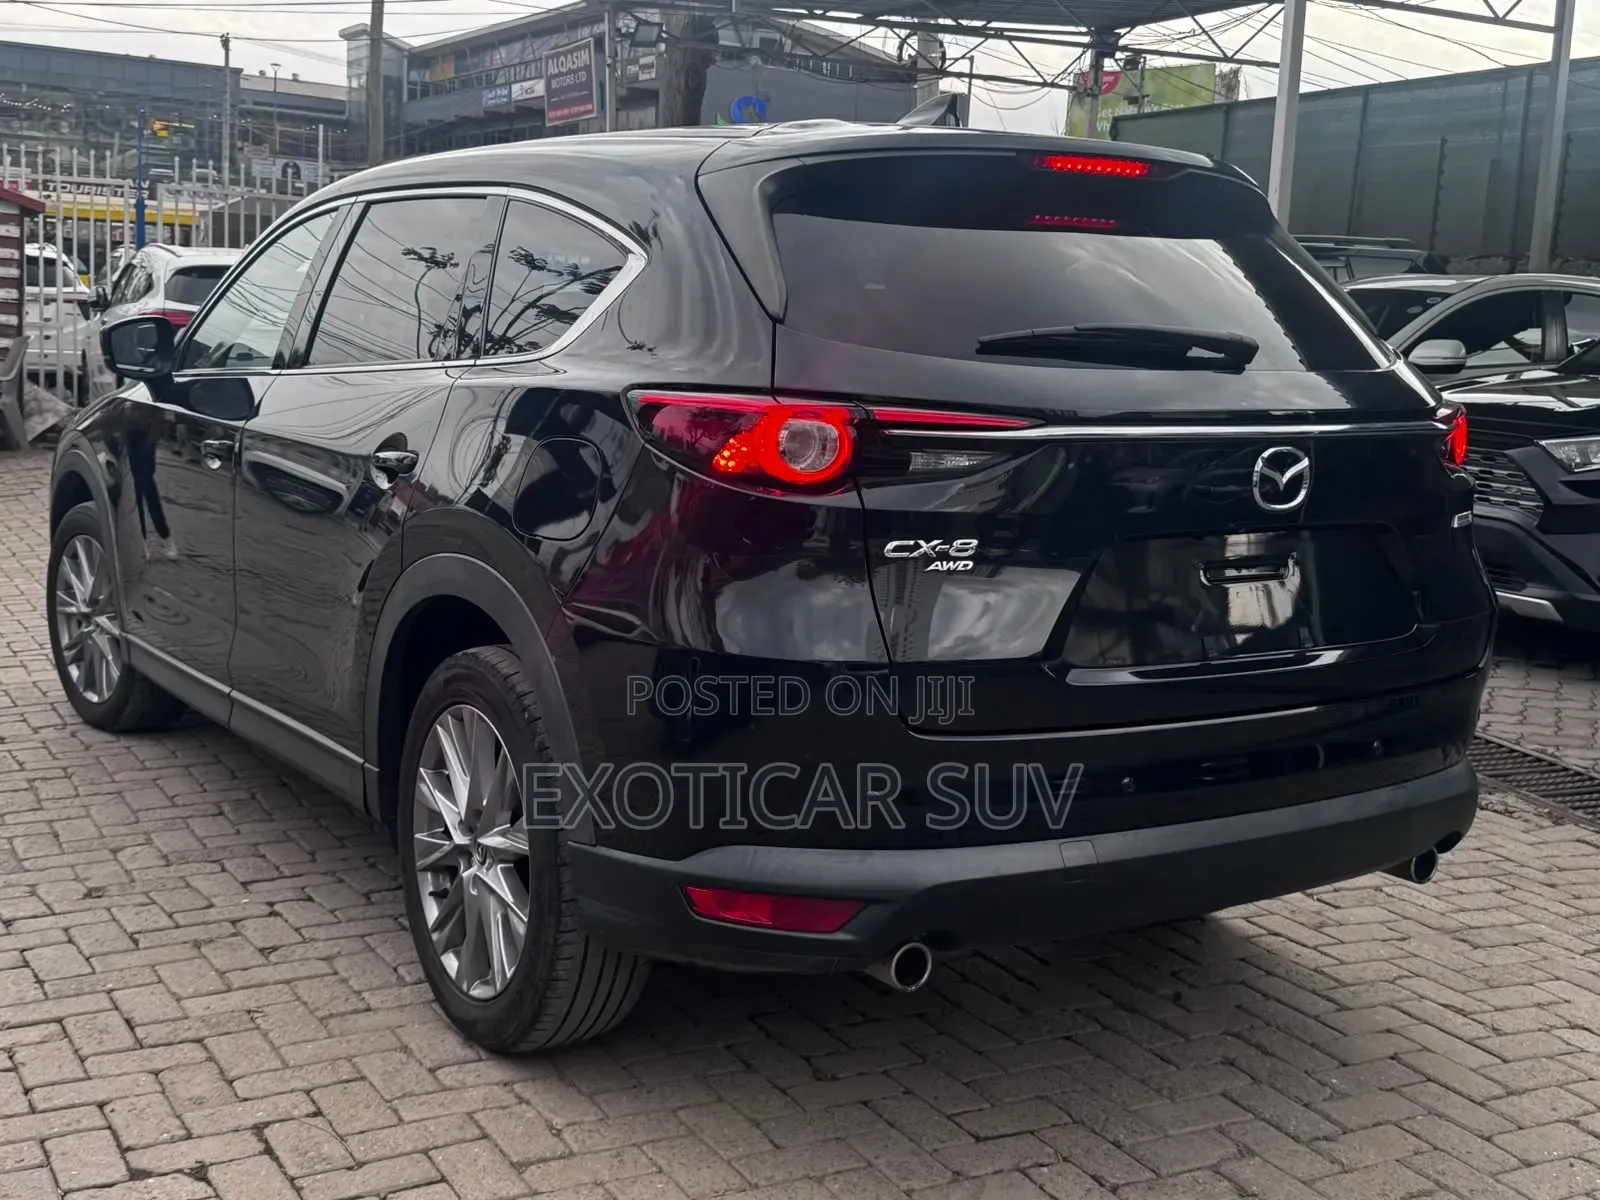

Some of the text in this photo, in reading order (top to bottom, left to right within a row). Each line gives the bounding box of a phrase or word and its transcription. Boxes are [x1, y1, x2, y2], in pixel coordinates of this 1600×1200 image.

[547, 48, 590, 76] ALQASIM
[551, 71, 587, 89] MOTORS LTD
[883, 538, 979, 558] CX-8
[924, 560, 974, 572] AWD
